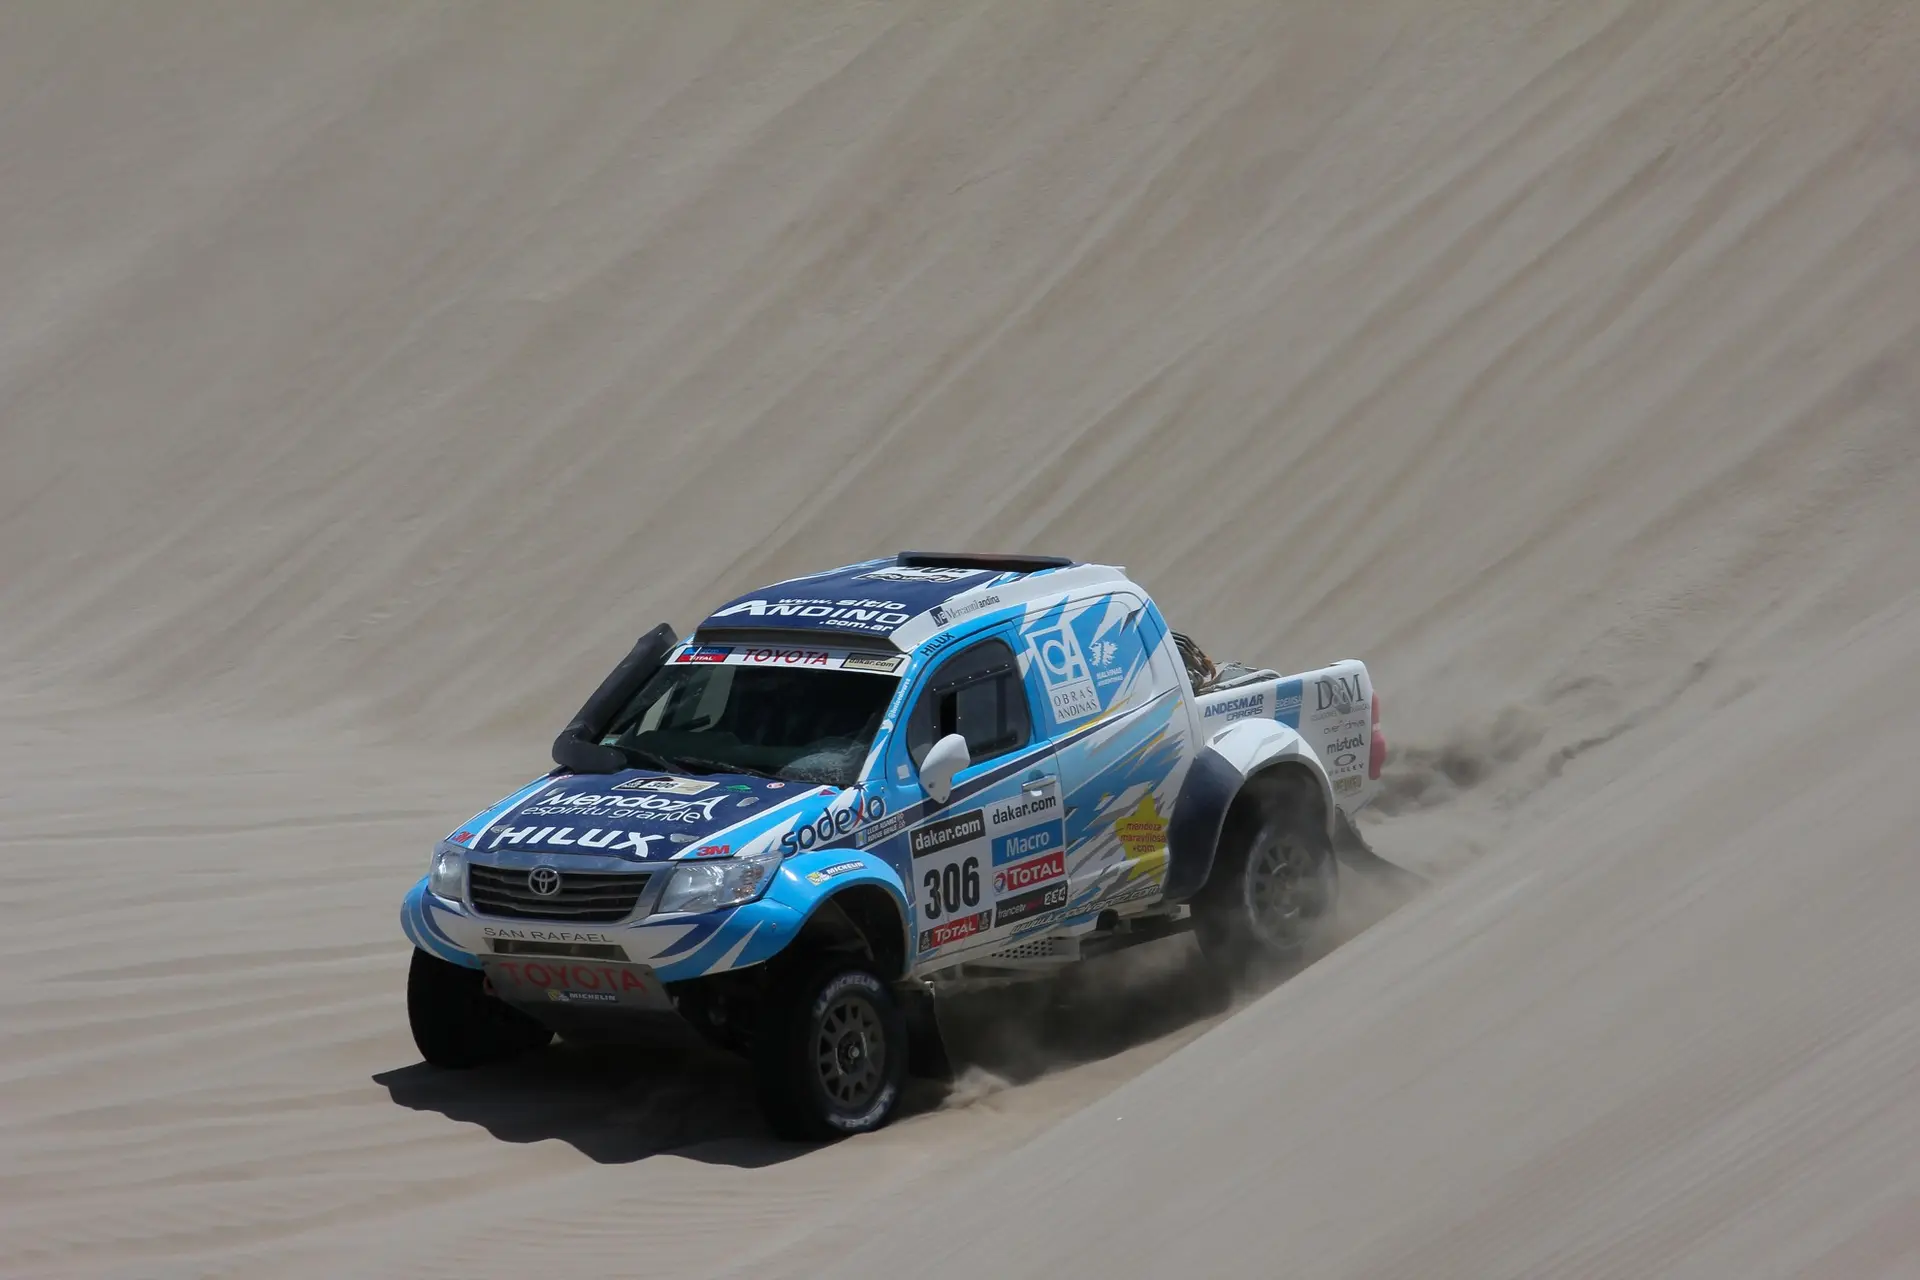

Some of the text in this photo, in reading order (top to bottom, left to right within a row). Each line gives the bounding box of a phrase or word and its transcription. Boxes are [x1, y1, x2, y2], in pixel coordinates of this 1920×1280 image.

[711, 600, 910, 624] ANDINO
[819, 619, 894, 632] .com.ar
[920, 632, 956, 656] HILUX
[742, 648, 829, 665] TOYOTA
[848, 657, 896, 668] dakar.com
[1054, 686, 1094, 706] OBRAS
[1314, 674, 1364, 711] D&M
[1057, 699, 1098, 720] ANDINAS
[1204, 694, 1264, 718] ANDESMAR
[1226, 706, 1264, 721] CARGAS
[1326, 733, 1364, 755] mistral
[608, 808, 701, 823] grande
[993, 794, 1057, 825] dakar.com
[781, 793, 886, 858] sodexo
[914, 821, 982, 850] dakar.com
[453, 831, 475, 843] 3M
[488, 826, 665, 858] HILUX
[1006, 831, 1050, 857] Macro
[696, 845, 731, 857] 3M
[826, 862, 864, 875] MICHELIN
[1010, 858, 1063, 885] TOTAL
[924, 856, 981, 920] 306
[484, 927, 614, 943] SAN RAFAEL
[934, 920, 976, 943] TOTAL
[500, 962, 649, 993] TOYOTA
[569, 992, 616, 1001] MICHELIN
